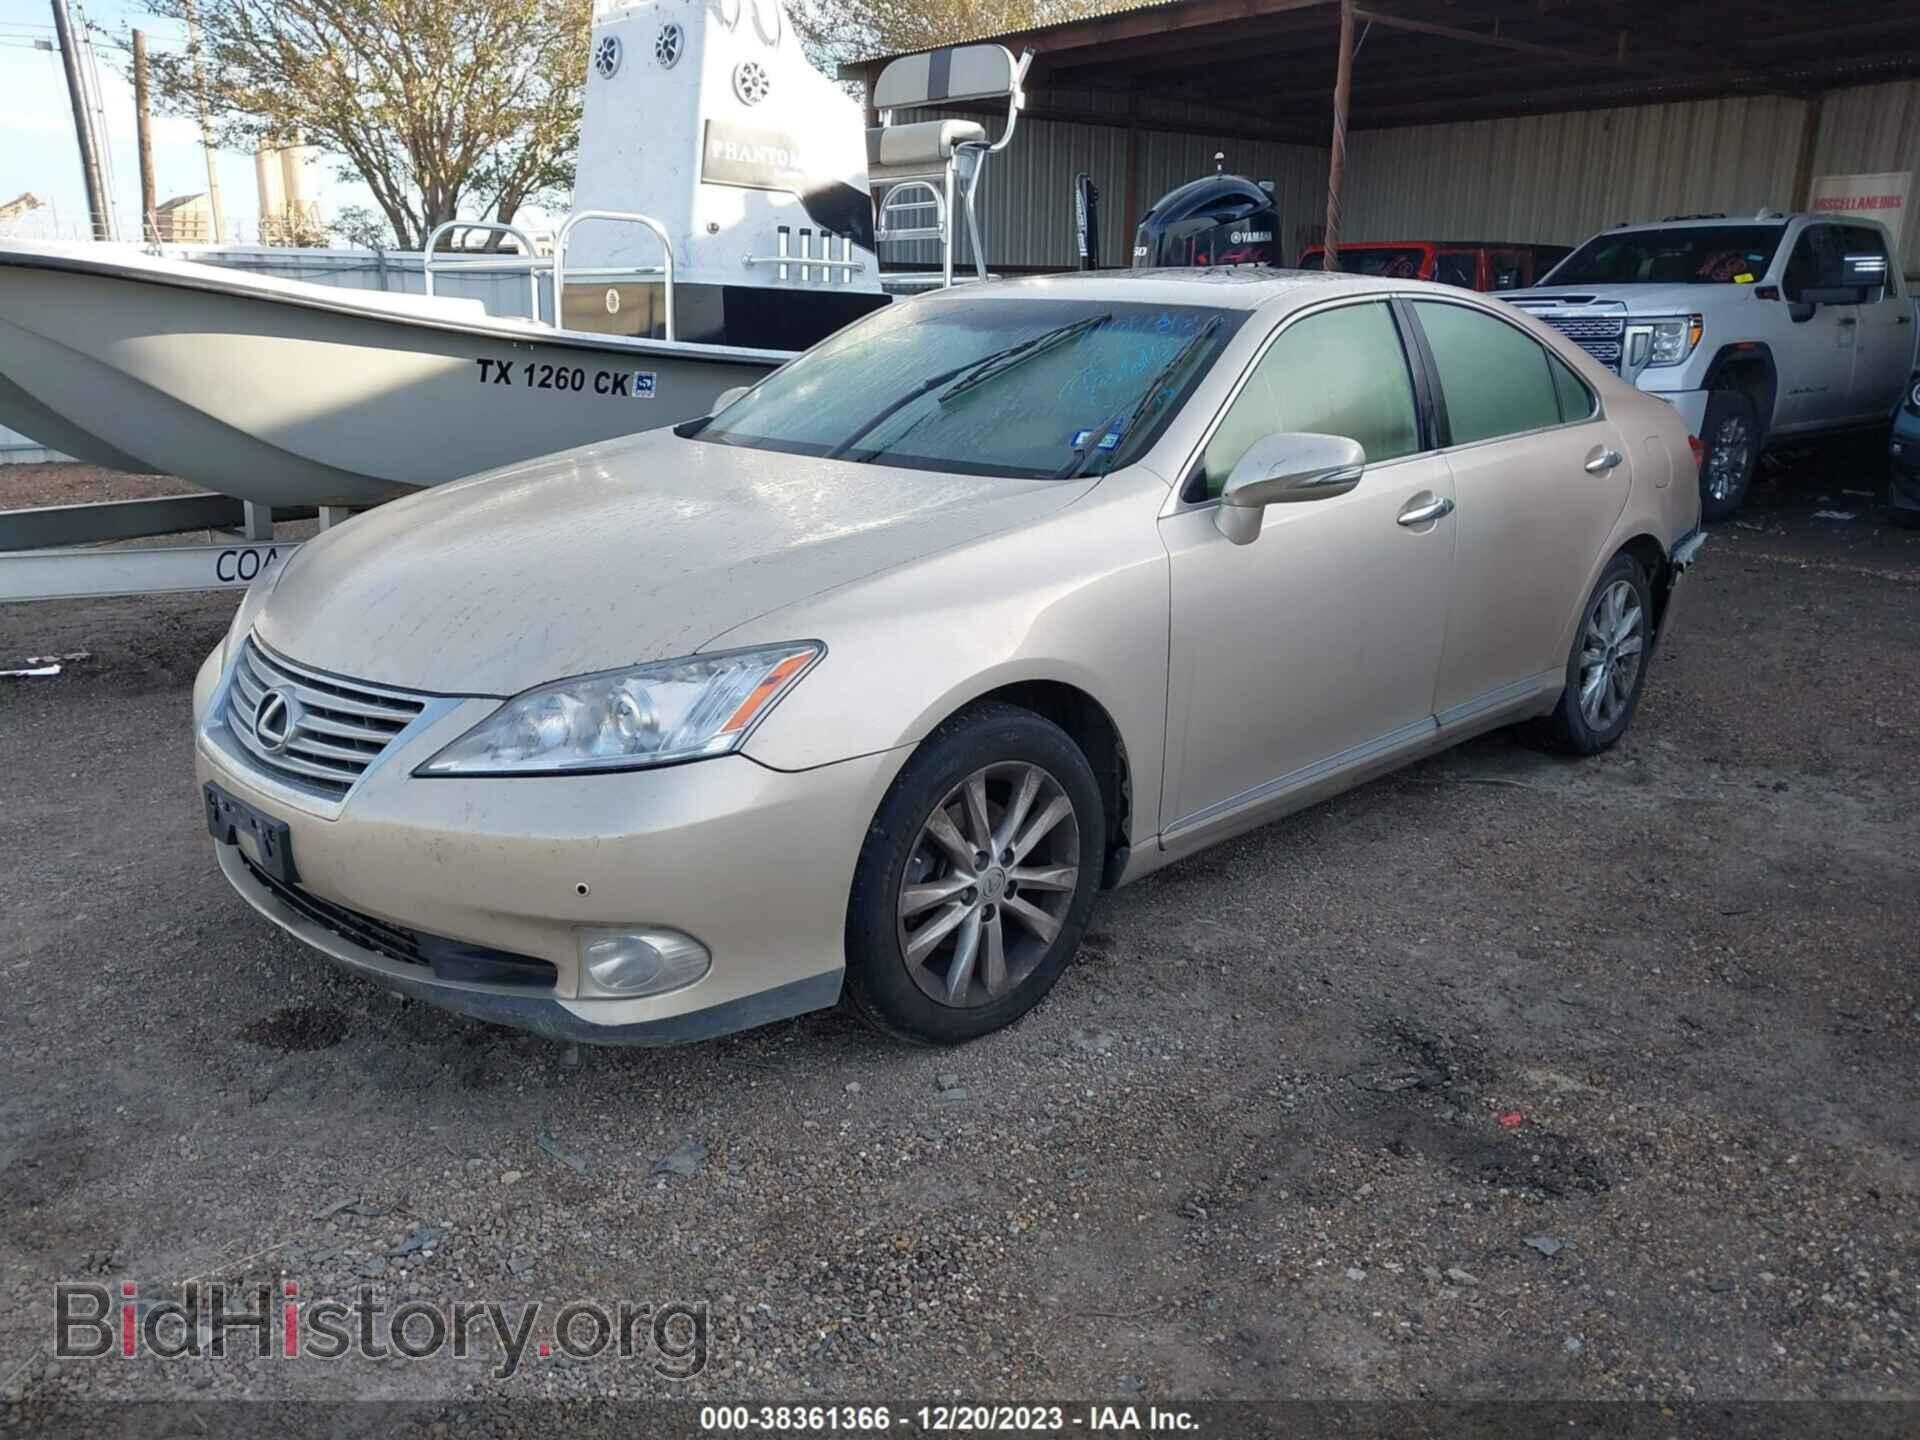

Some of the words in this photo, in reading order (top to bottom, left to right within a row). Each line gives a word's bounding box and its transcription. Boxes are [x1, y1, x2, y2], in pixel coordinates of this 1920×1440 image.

[1241, 231, 1273, 243] YAMAHA
[476, 357, 514, 386] TX
[524, 362, 585, 392] 1260
[593, 370, 631, 397] CK
